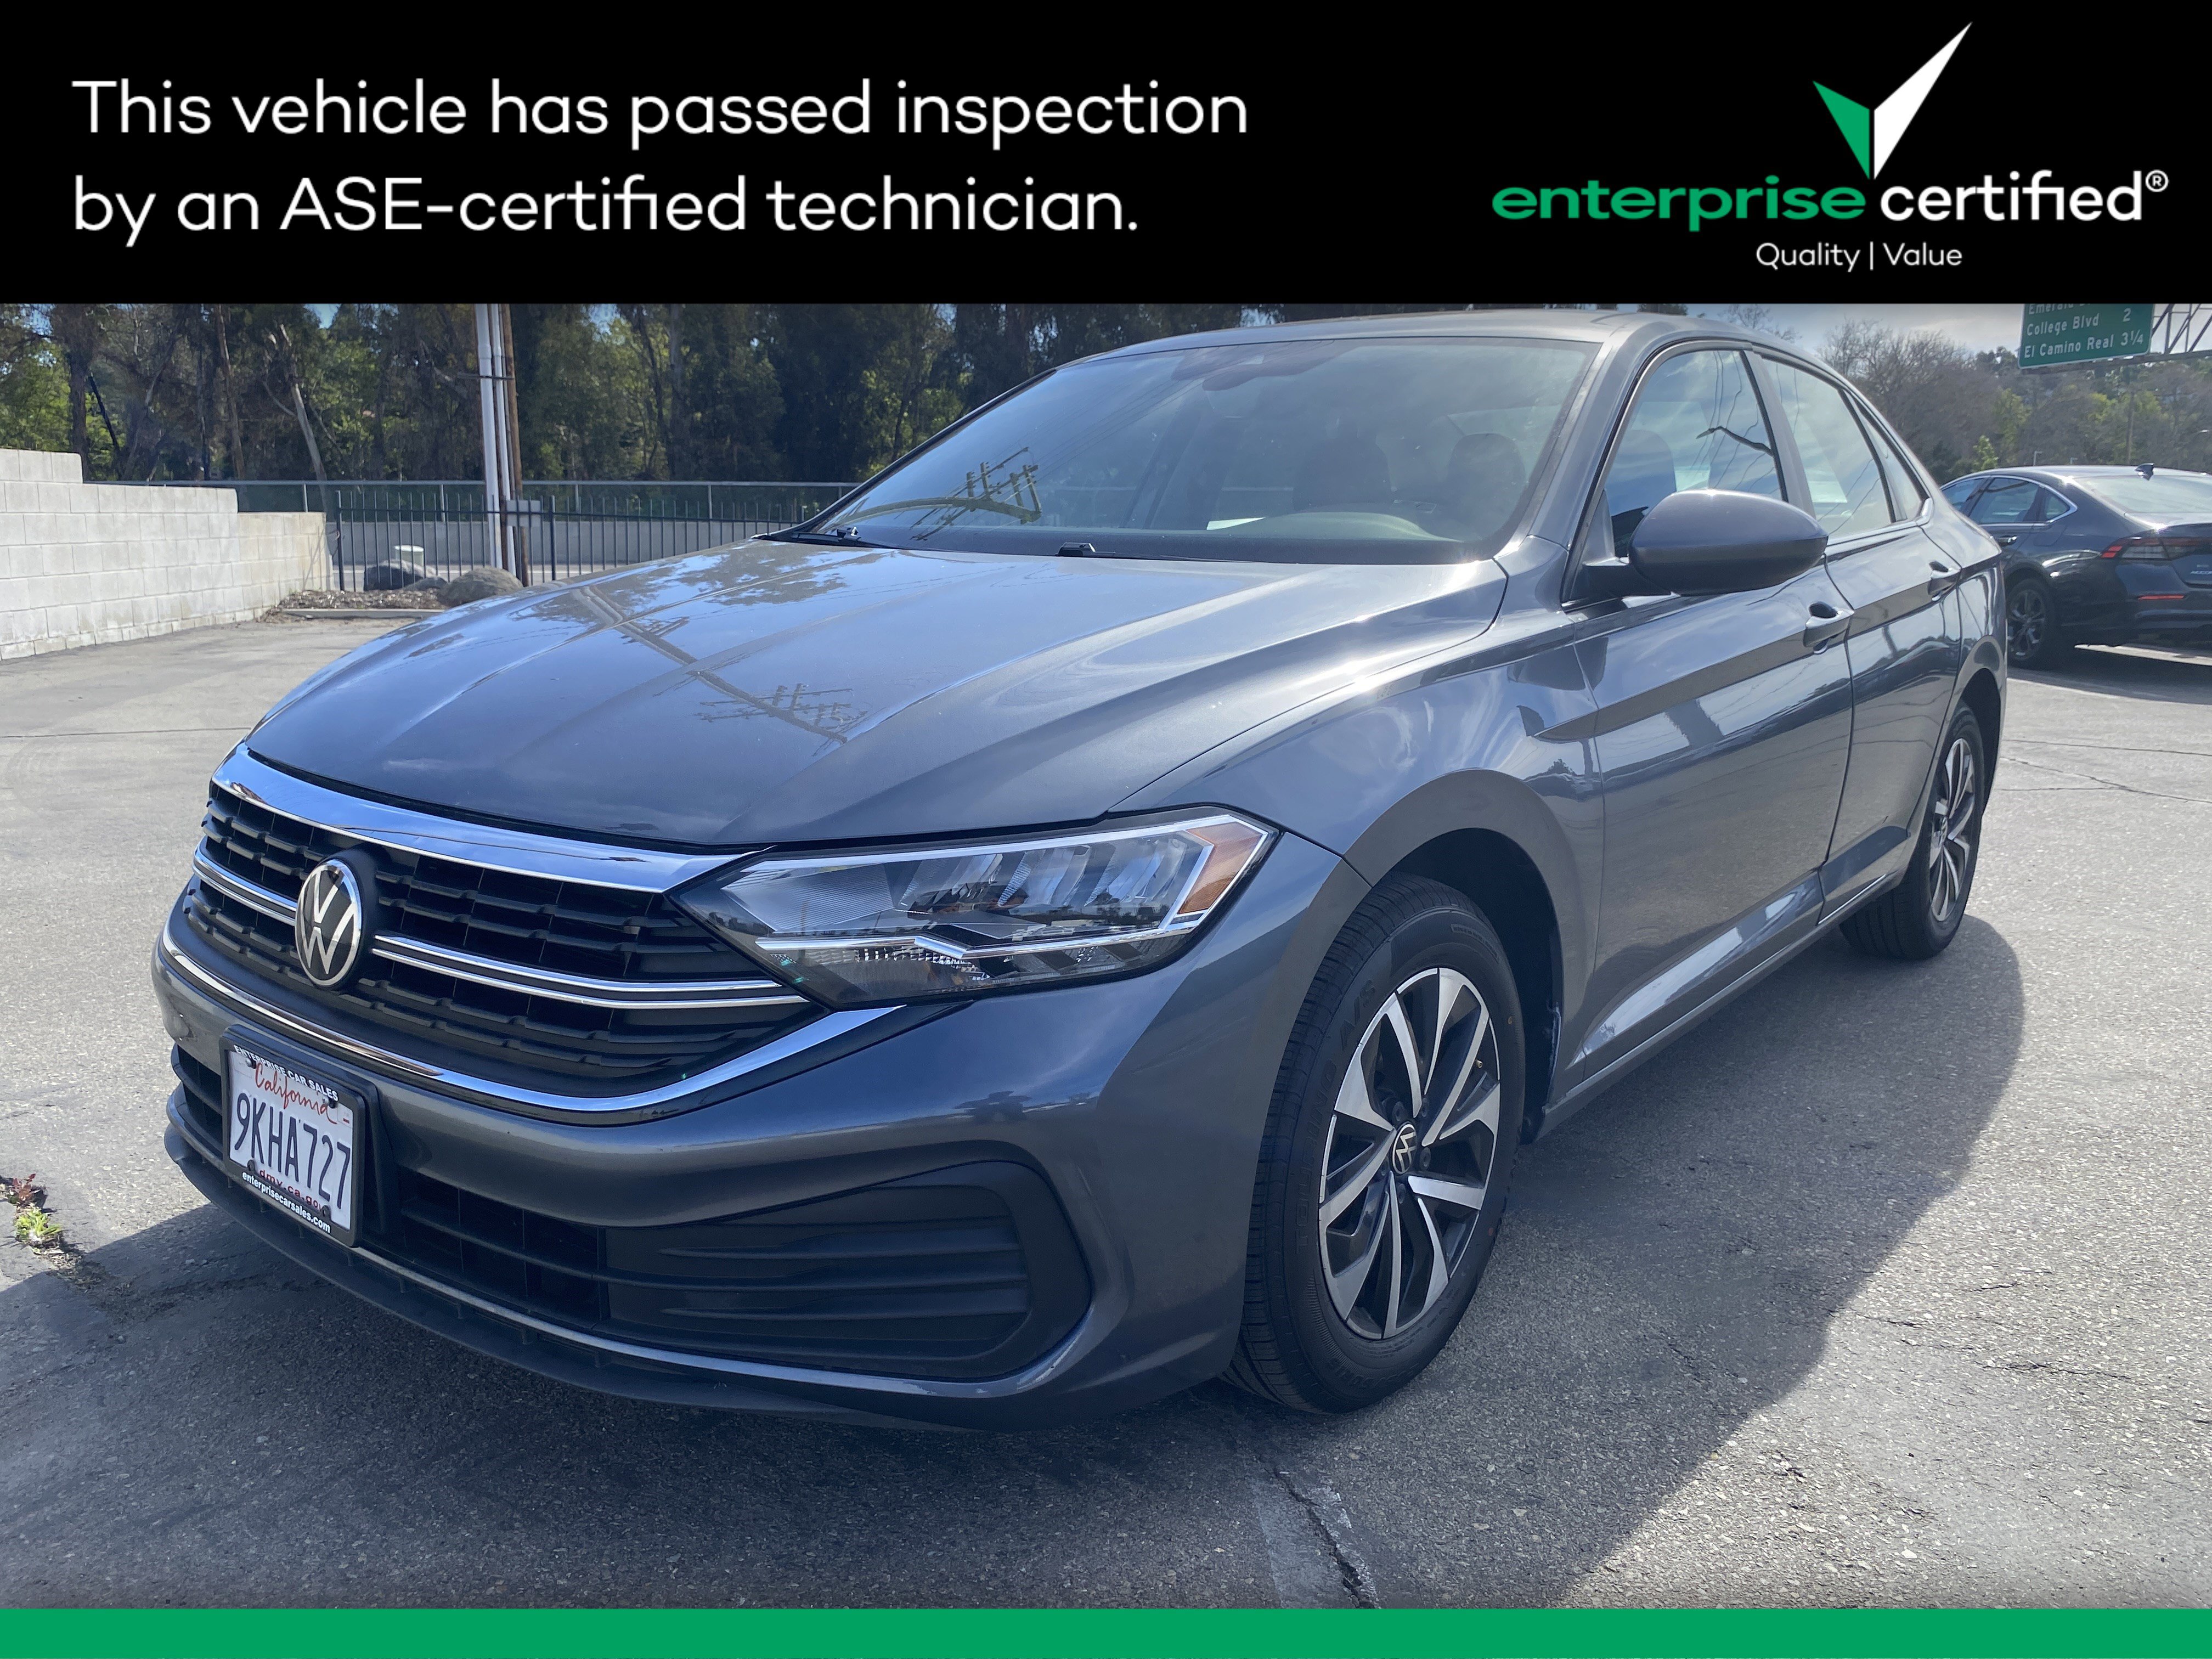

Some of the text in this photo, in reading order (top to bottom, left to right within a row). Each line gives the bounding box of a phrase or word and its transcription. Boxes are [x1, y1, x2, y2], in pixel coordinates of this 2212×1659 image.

[2024, 345, 2035, 358] El
[2040, 341, 2081, 356] Camino
[2087, 334, 2114, 350] Real
[2027, 308, 2131, 336] College Blvd 2
[233, 1044, 338, 1102] ENTERPRISE CAR SALES
[255, 1063, 337, 1124] California
[234, 1092, 351, 1210] 9KHA727
[242, 1171, 331, 1234] enterprisecarsales.com
